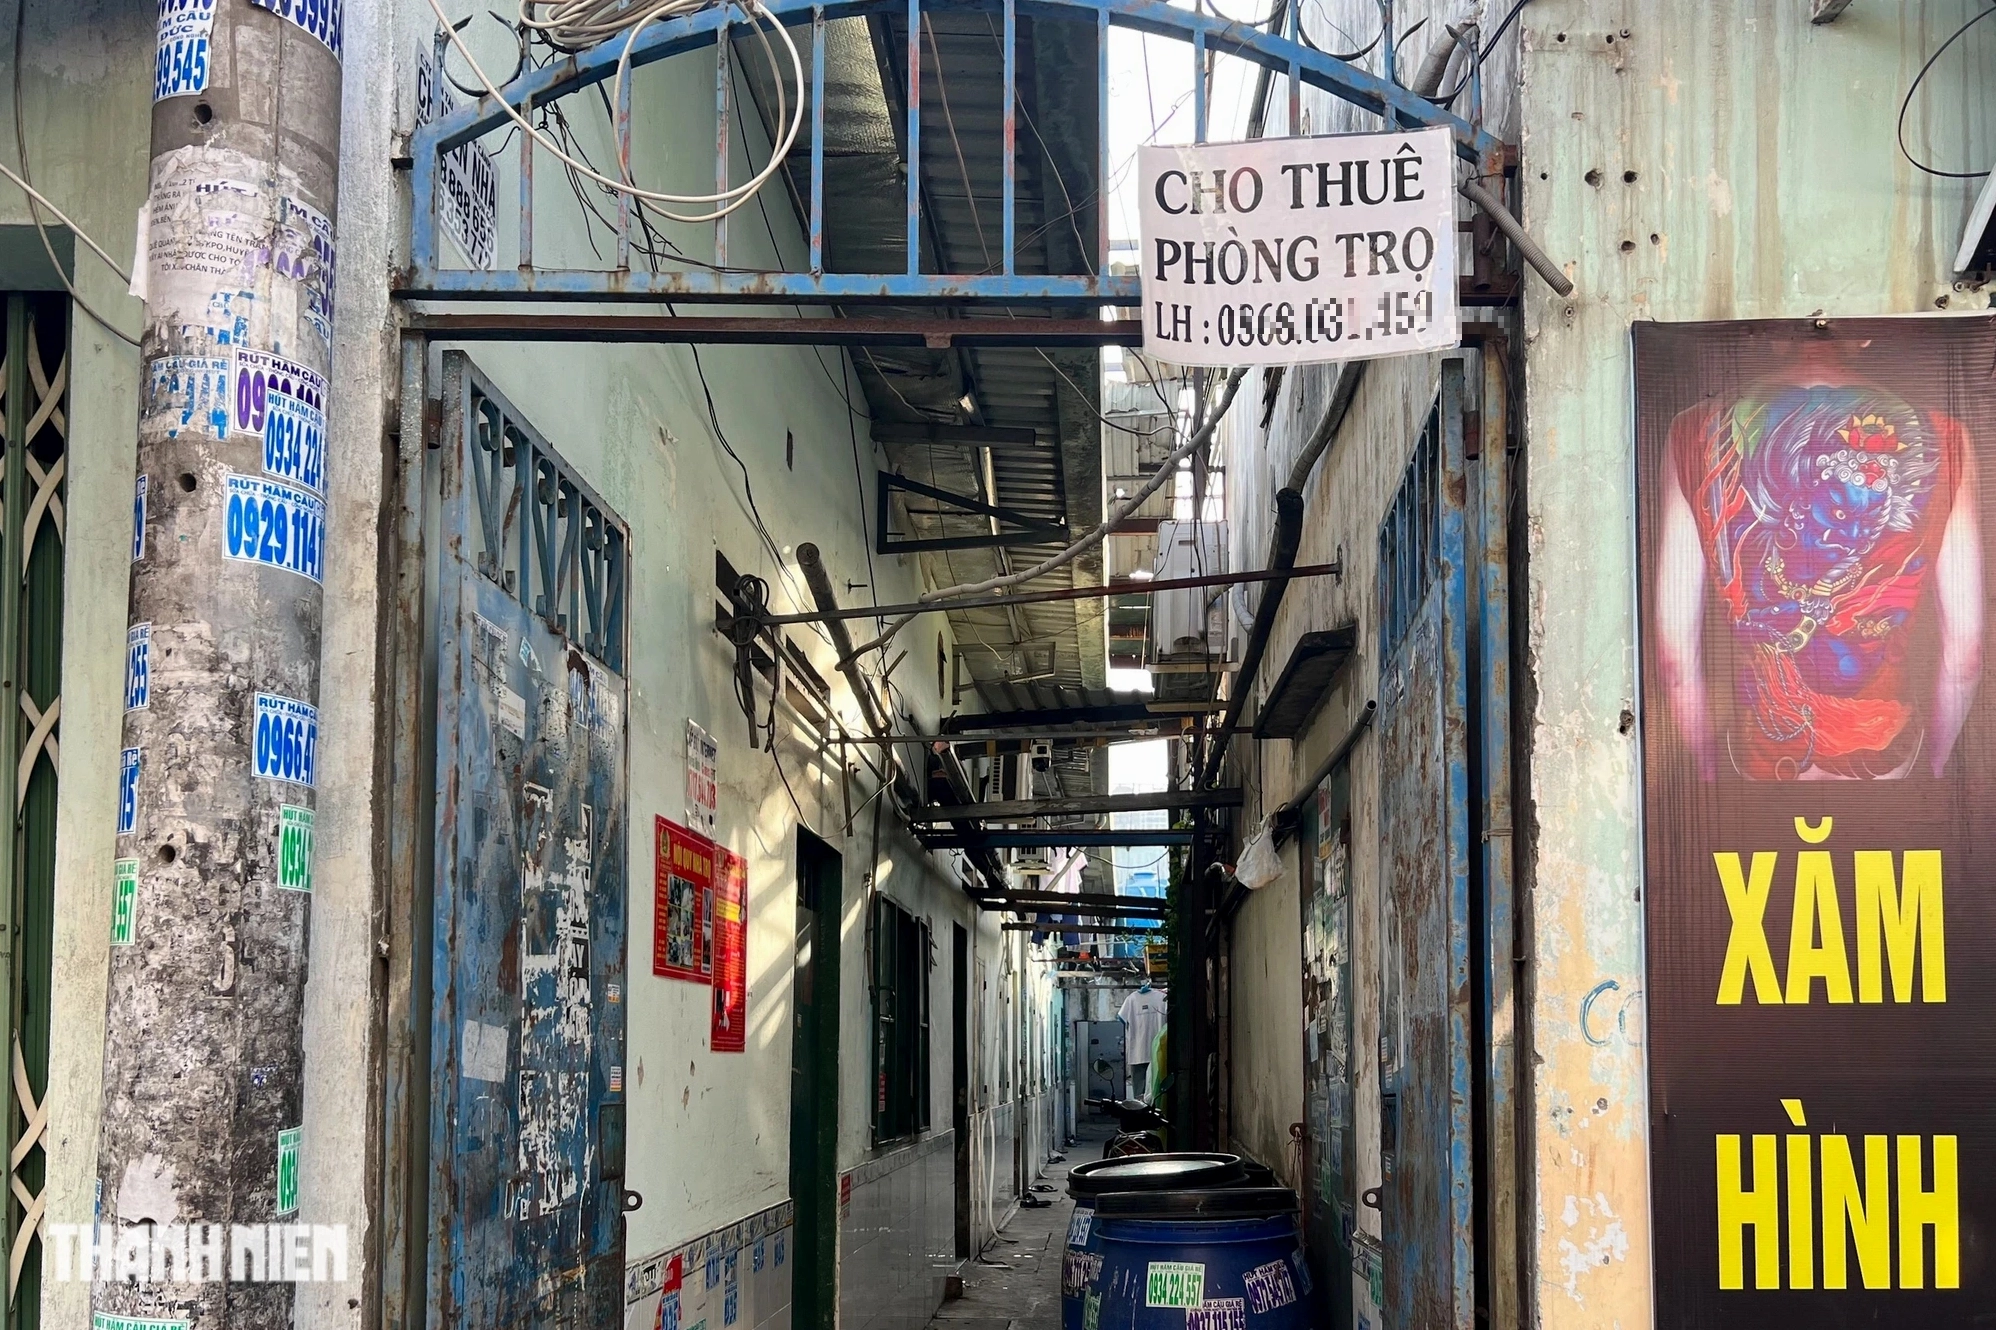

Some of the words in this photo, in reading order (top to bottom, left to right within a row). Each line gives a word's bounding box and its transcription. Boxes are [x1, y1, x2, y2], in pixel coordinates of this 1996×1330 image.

[154, 38, 207, 98] 99.545
[1154, 166, 1264, 215] CHO
[1281, 142, 1425, 209] THUÊ
[448, 168, 471, 220] 888
[472, 205, 495, 254] 656
[225, 232, 243, 244] TÊN
[208, 253, 227, 263] CHO
[229, 258, 241, 266] TÔ
[1154, 226, 1320, 286] PHÒNG
[1334, 226, 1434, 283] TRỌ
[238, 351, 270, 366] RÚT
[268, 393, 287, 408] HÚT
[228, 478, 260, 491] RÚT
[263, 484, 292, 500] HẦM
[259, 697, 286, 710] RÚT
[1713, 816, 1947, 1006] XĂM
[1714, 1099, 1960, 1291] HÌNH
[1203, 1299, 1212, 1308] ẦM
